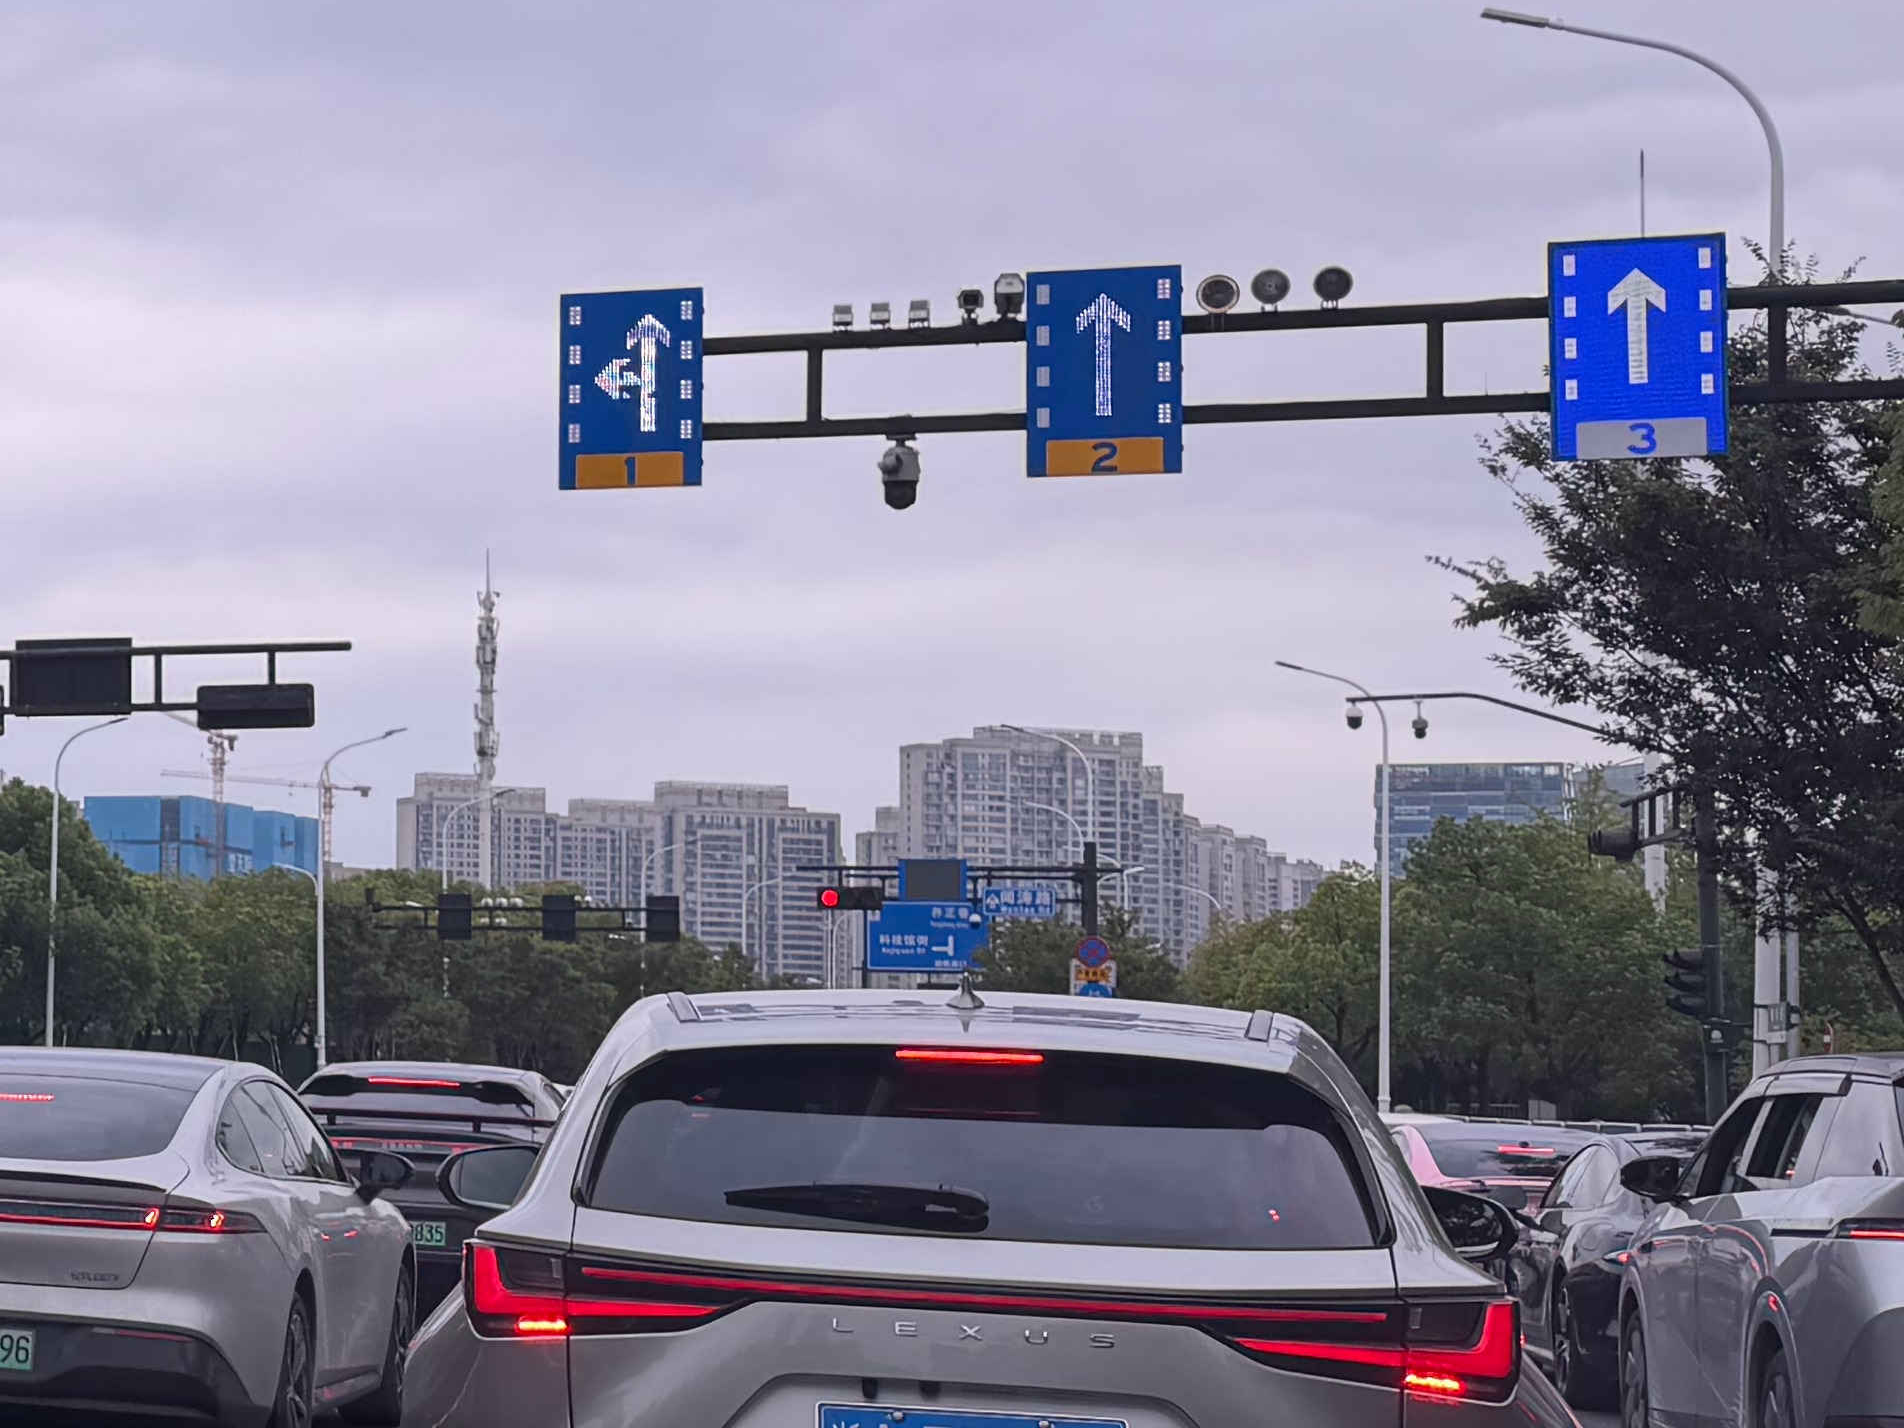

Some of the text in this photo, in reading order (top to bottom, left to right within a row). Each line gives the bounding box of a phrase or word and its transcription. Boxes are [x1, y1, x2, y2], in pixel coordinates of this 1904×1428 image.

[1627, 422, 1657, 455] 3
[624, 456, 637, 486] 1
[1091, 441, 1118, 472] 2
[409, 1223, 445, 1244] 835
[832, 1318, 1115, 1349] LEXUS
